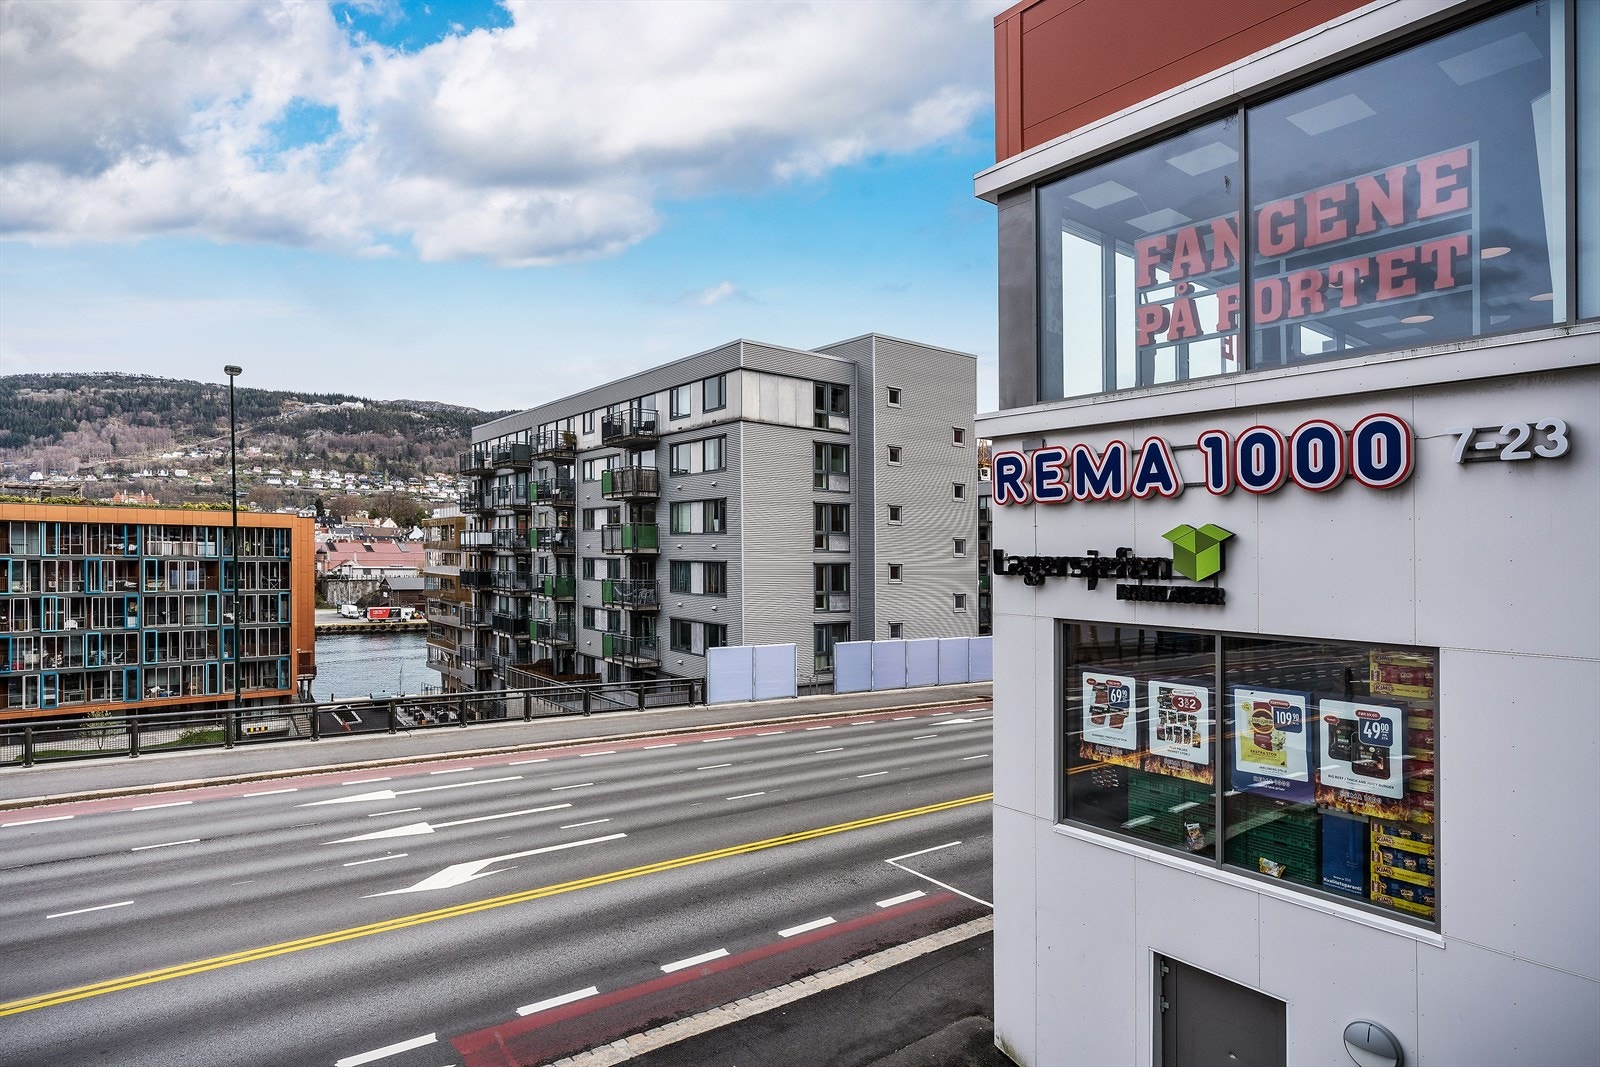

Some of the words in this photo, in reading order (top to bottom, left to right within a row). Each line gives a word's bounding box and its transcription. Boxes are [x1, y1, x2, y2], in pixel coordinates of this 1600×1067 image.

[1135, 147, 1471, 289] FANGENE
[1137, 284, 1203, 347] PÅ
[1216, 235, 1472, 332] FORTET
[992, 435, 1185, 506] REMA
[1197, 412, 1416, 496] 1000
[1448, 417, 1571, 465] 7-23
